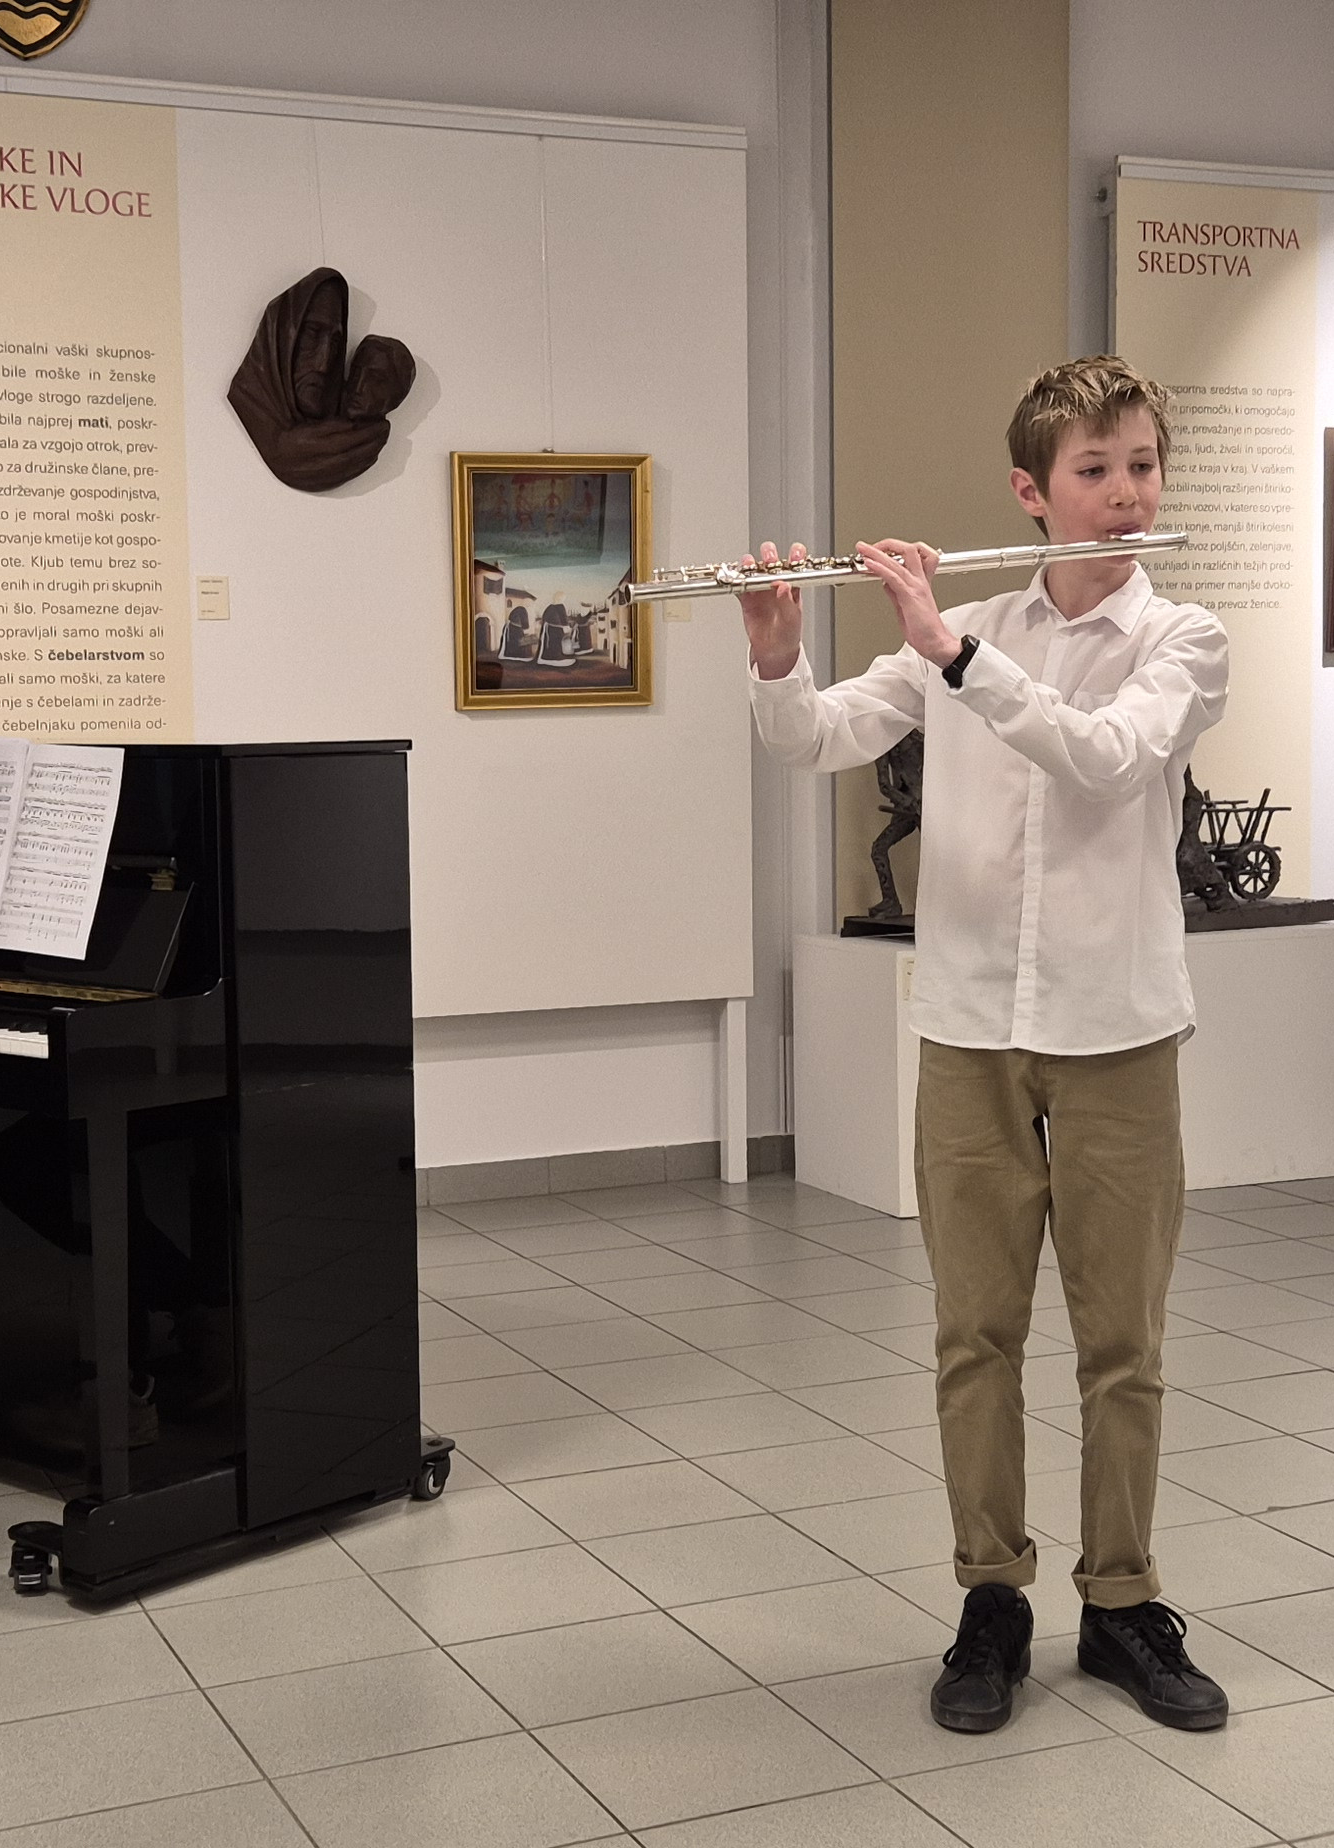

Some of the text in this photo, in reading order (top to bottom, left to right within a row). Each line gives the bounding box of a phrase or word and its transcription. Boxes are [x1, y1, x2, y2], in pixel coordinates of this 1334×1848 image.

[48, 150, 82, 177] IN
[46, 186, 151, 217] VLOGE
[1137, 221, 1299, 249] TRANSPORTNA
[1139, 251, 1251, 276] SREDSTVA
[56, 344, 88, 356] vaški
[96, 345, 155, 360] skupnos-
[2, 365, 26, 378] bile
[36, 368, 80, 380] moške
[89, 369, 100, 380] in
[109, 370, 155, 383] ženske
[39, 392, 81, 406] strogo
[87, 393, 156, 408] razdeljene.
[0, 413, 21, 425] bila
[28, 415, 72, 429] najprej
[78, 417, 111, 429] mati,
[118, 418, 157, 430] poskr-
[23, 440, 37, 449] za
[41, 439, 83, 453] vzgojo
[87, 440, 122, 453] otrok,
[127, 443, 157, 454] prev-
[7, 464, 21, 473] za
[25, 461, 88, 474] družinske
[92, 463, 130, 476] člane,
[134, 467, 158, 477] pre-
[70, 487, 159, 501] gospodinjstva,
[15, 509, 26, 522] je
[33, 509, 69, 521] moral
[77, 510, 114, 521] moški
[121, 511, 160, 524] poskr-
[45, 533, 92, 547] kmetije
[95, 533, 113, 545] kot
[117, 536, 161, 548] gospo-
[32, 556, 63, 570] Kljub
[70, 557, 102, 568] temu
[109, 557, 136, 568] brez
[142, 560, 161, 568] so-
[1, 579, 29, 591] enih
[33, 582, 44, 590] in
[47, 579, 89, 594] drugih
[93, 580, 109, 593] pri
[112, 580, 162, 593] skupnih
[14, 602, 35, 614] šlo.
[42, 602, 119, 614] Posamezne
[125, 603, 163, 617] dejav-
[63, 629, 99, 638] samo
[106, 626, 143, 638] moški
[150, 626, 163, 637] ali
[35, 649, 43, 661] S
[48, 649, 144, 660] čebelarstvom
[150, 652, 164, 660] so
[19, 675, 55, 684] samo
[60, 673, 102, 685] moški,
[107, 675, 121, 684] za
[126, 672, 165, 683] katere
[27, 699, 33, 707] s
[38, 696, 98, 707] čebelami
[103, 698, 114, 706] in
[119, 695, 165, 706] zadrže-
[2, 719, 75, 733] čebelnjaku
[81, 718, 141, 732] pomenila
[146, 718, 166, 729] od-
